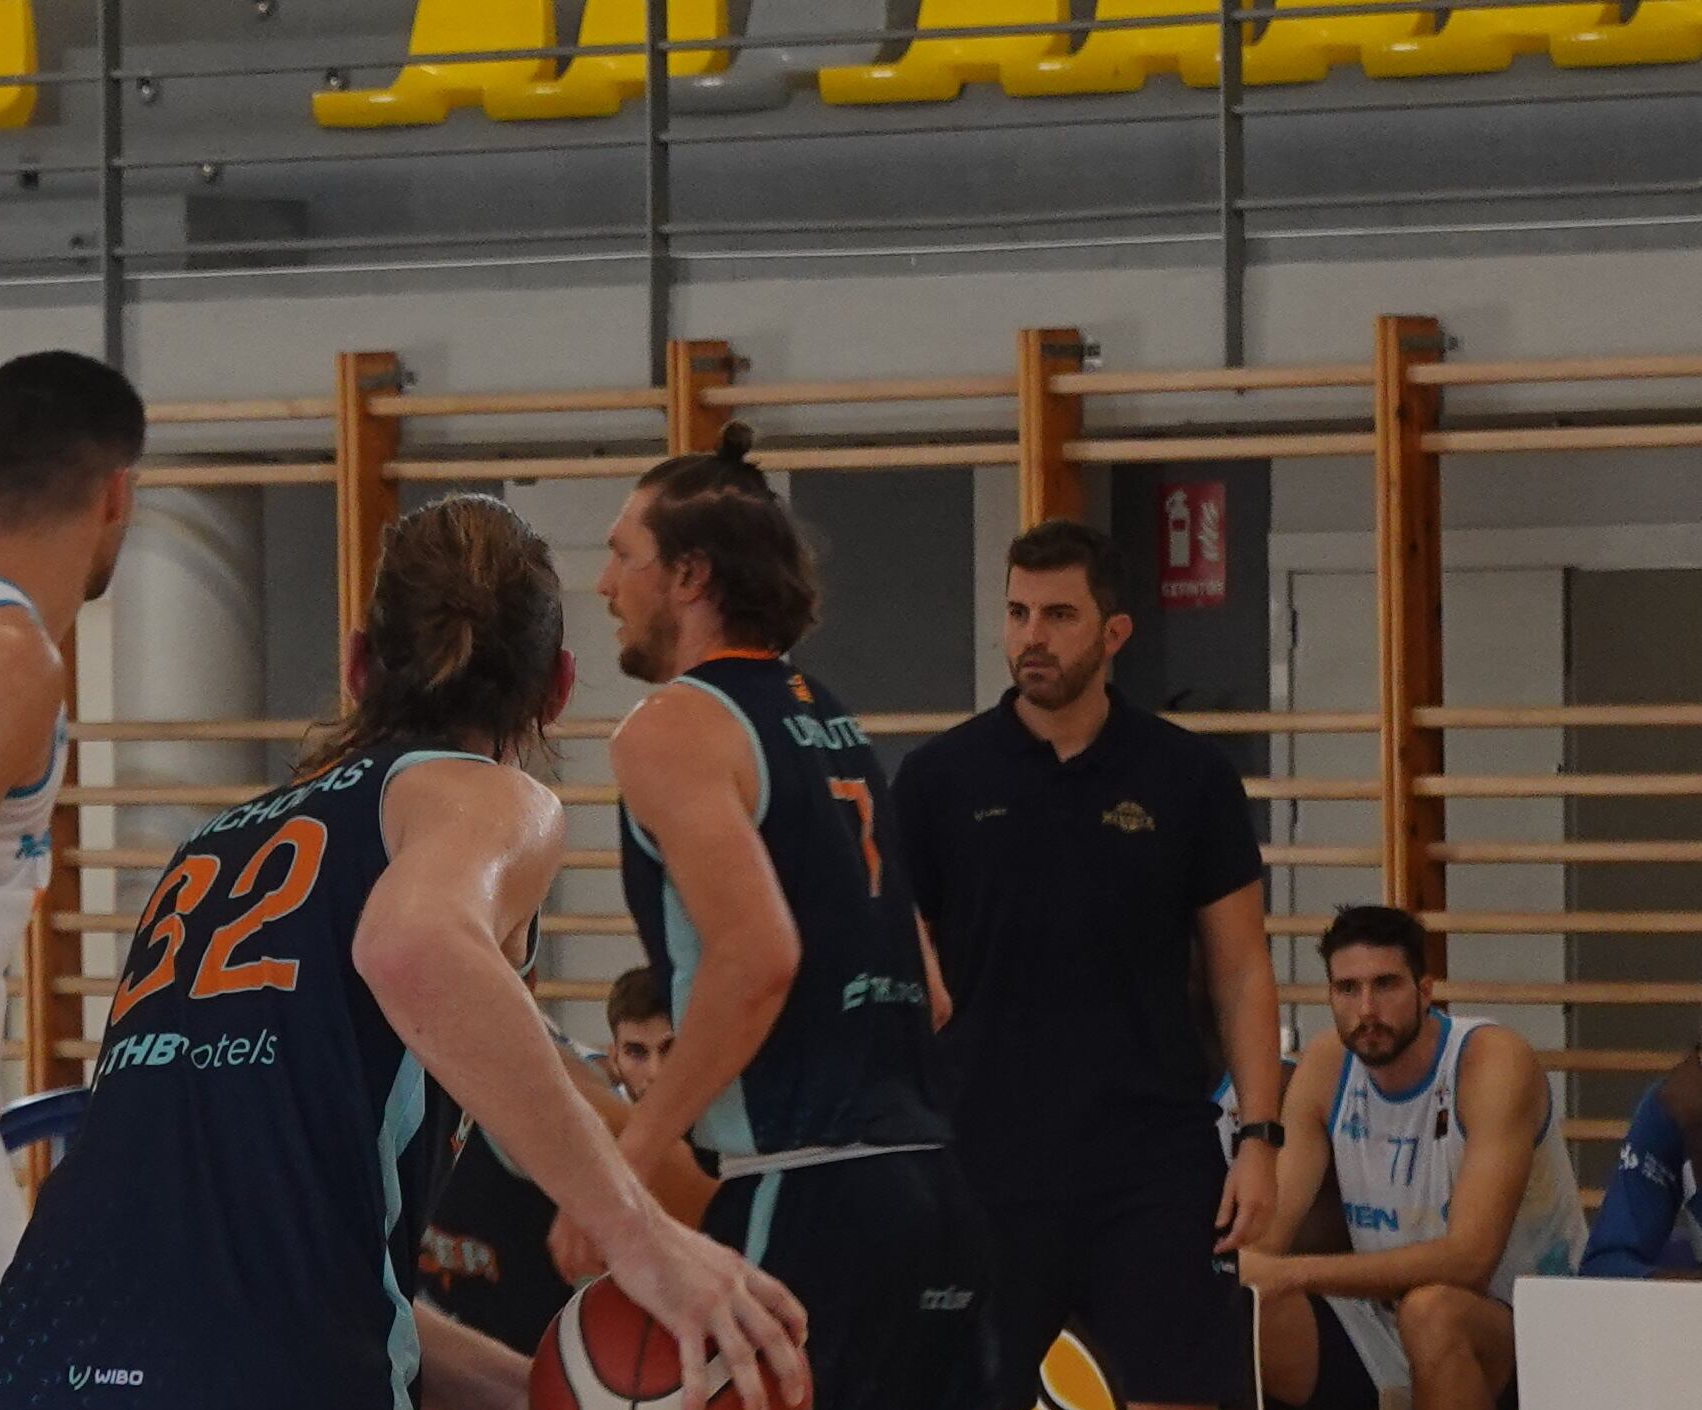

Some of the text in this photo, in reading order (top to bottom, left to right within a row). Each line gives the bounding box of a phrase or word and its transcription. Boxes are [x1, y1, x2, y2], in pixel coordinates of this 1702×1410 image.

[827, 775, 884, 898] 7
[111, 815, 328, 1027] 32
[1388, 1136, 1420, 1187] 77
[94, 1368, 144, 1386] WIBO
